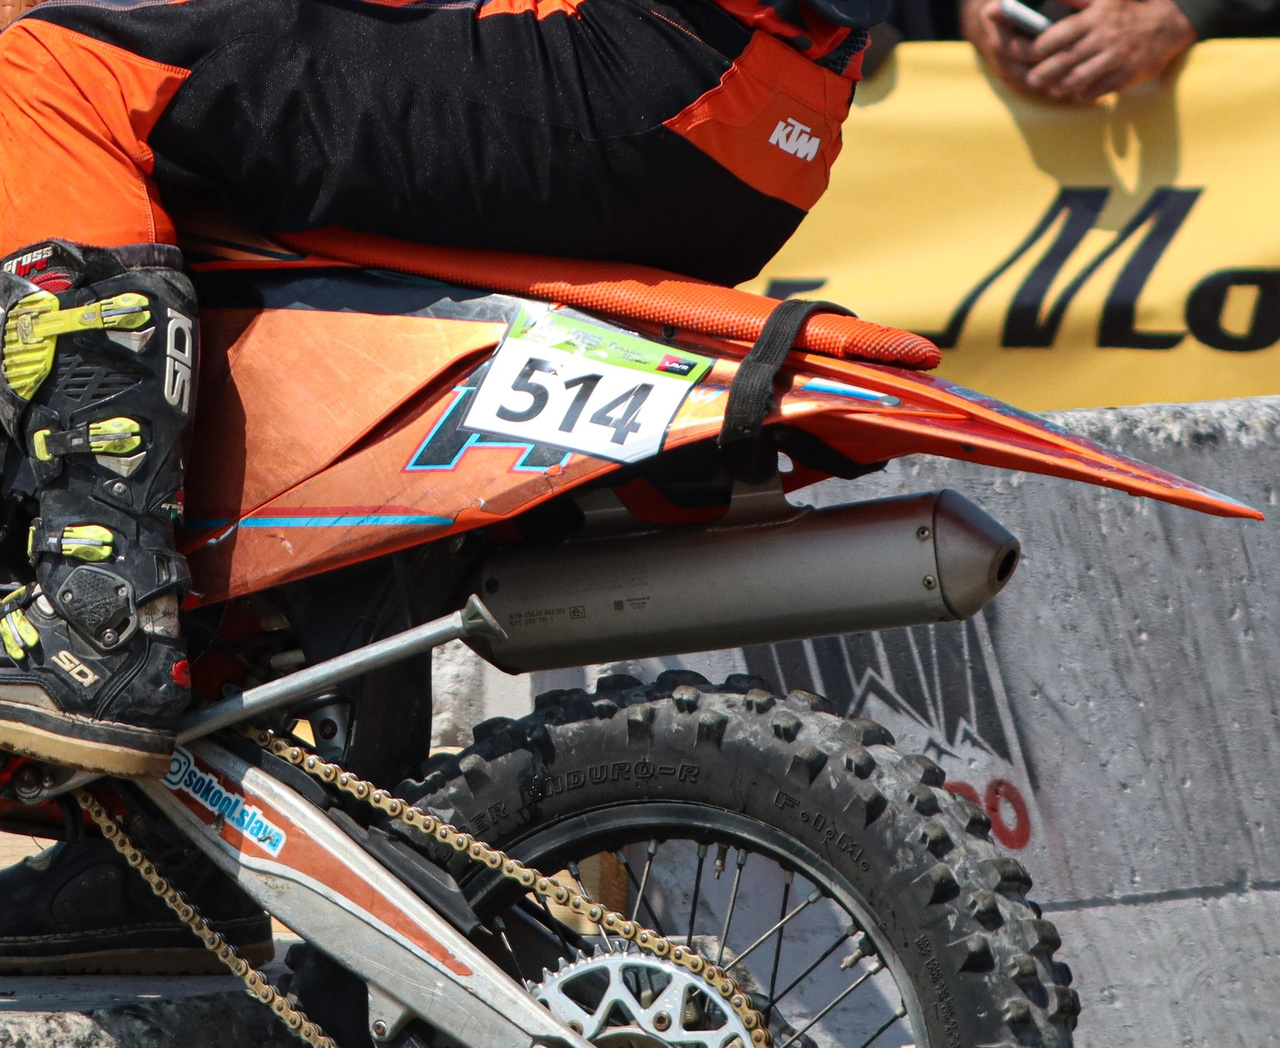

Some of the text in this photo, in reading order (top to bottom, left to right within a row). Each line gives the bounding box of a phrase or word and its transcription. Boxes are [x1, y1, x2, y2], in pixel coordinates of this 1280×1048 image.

[768, 117, 821, 162] KTM
[664, 360, 690, 371] LAVR
[496, 357, 655, 446] 514
